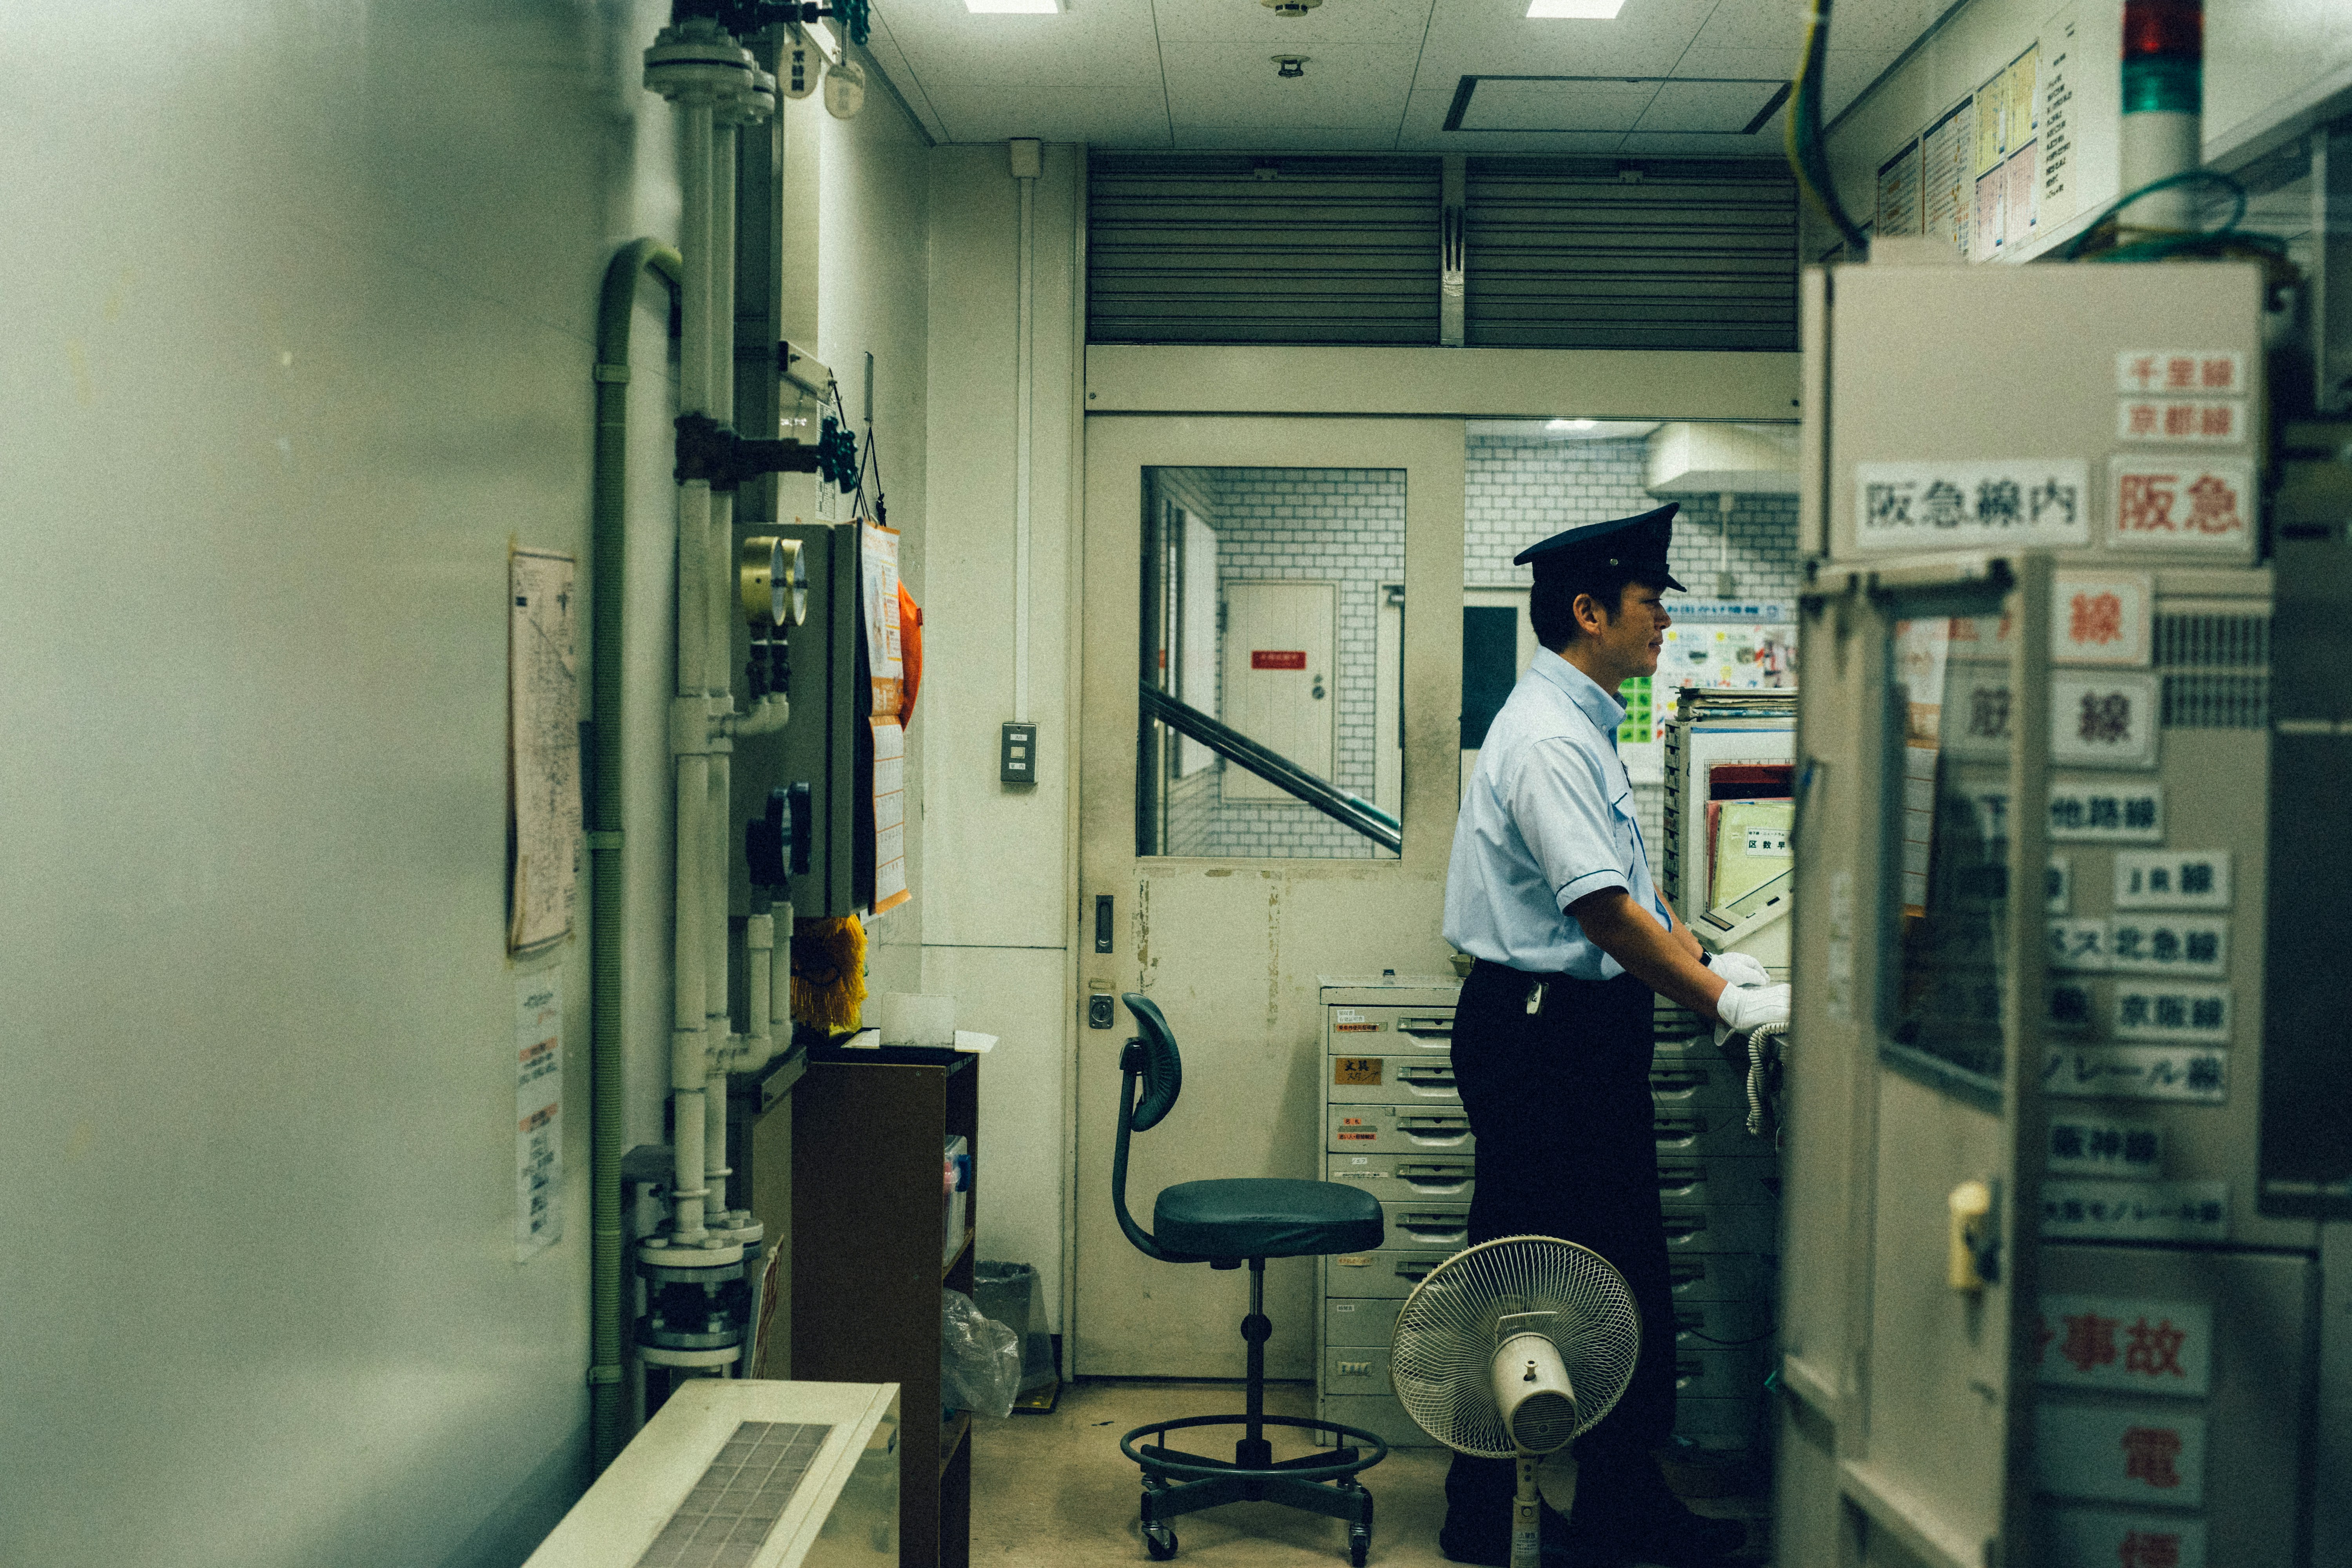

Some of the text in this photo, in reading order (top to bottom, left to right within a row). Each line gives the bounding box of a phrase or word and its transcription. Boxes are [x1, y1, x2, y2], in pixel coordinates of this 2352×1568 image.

[2130, 356, 2234, 388] 千里線
[2130, 403, 2233, 435] 京都線
[1864, 477, 2078, 529] 阪急線内
[2119, 475, 2242, 534] 阪急
[2040, 1313, 2186, 1378] 事故
